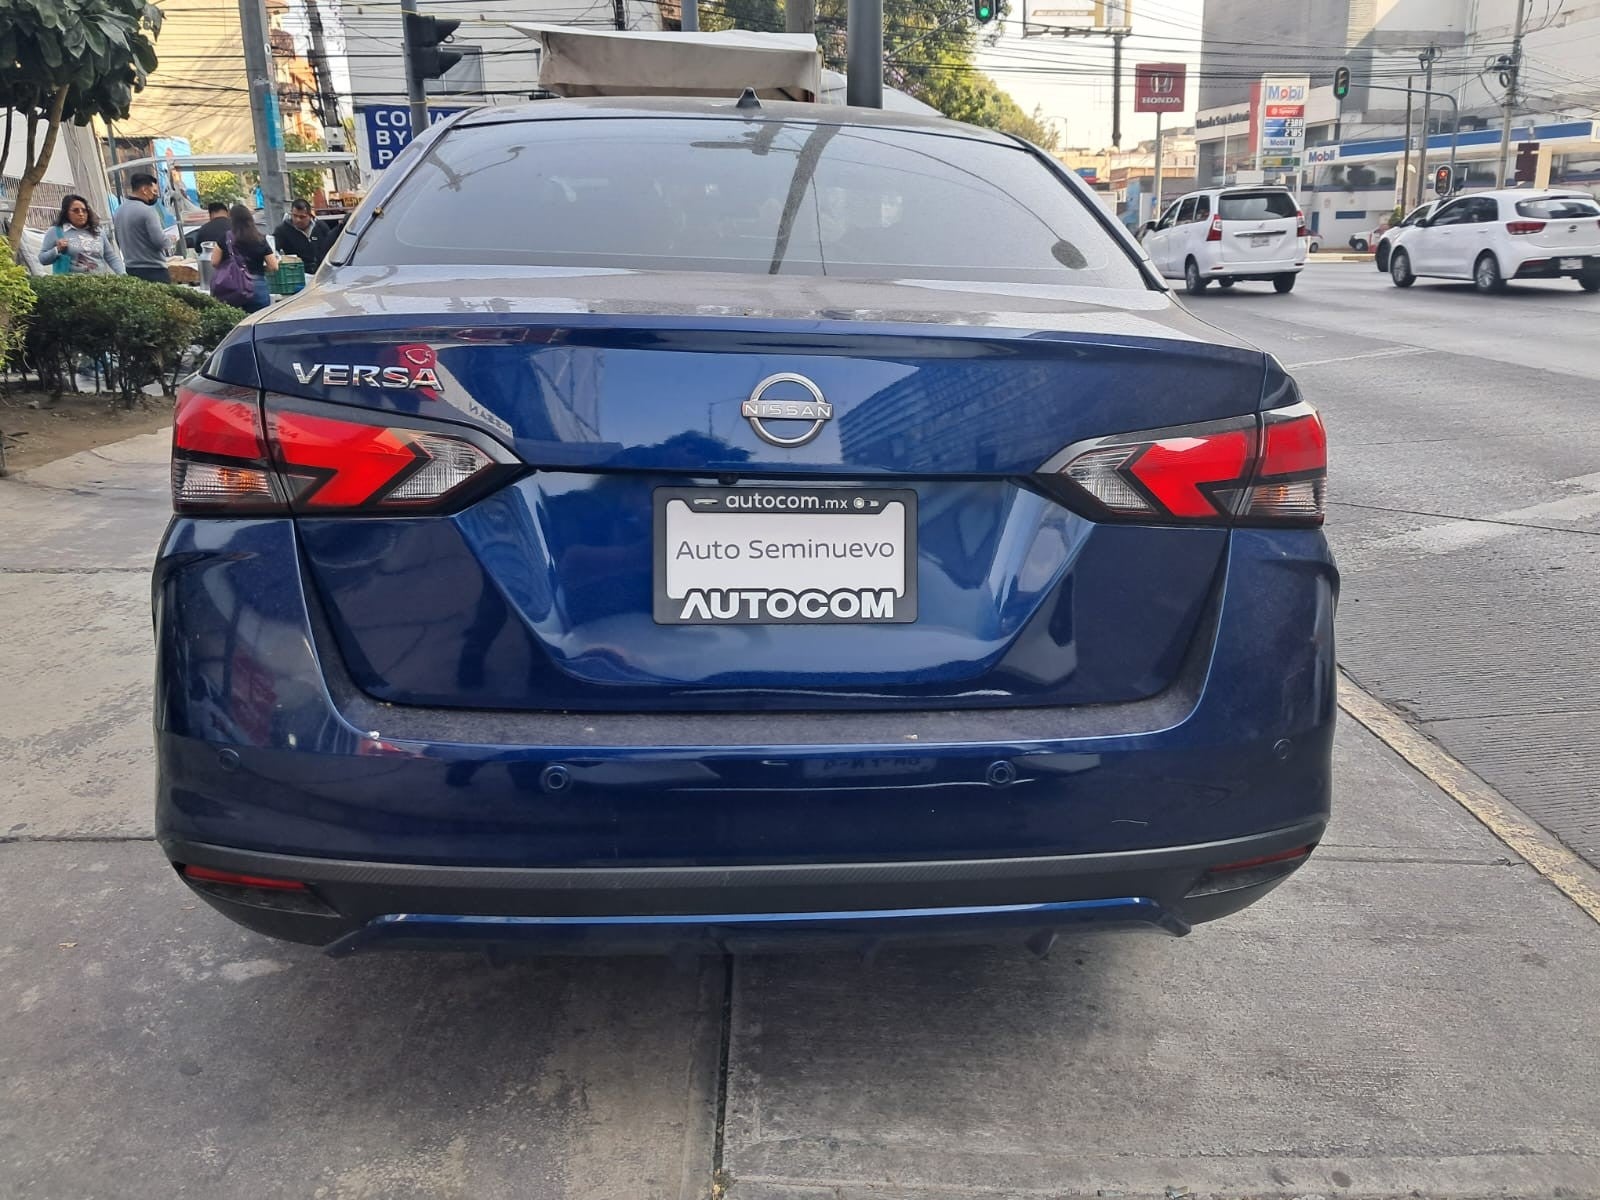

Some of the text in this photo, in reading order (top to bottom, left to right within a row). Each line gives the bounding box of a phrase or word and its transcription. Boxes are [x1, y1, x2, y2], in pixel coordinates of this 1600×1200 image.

[1268, 85, 1304, 100] Mobil
[1309, 150, 1335, 163] Mobil
[292, 362, 444, 392] VERSA
[744, 403, 831, 417] NISSAN
[725, 492, 848, 509] autocom.mx
[676, 538, 895, 560] Auto Seminuevo
[679, 591, 895, 619] AUTOCOM
